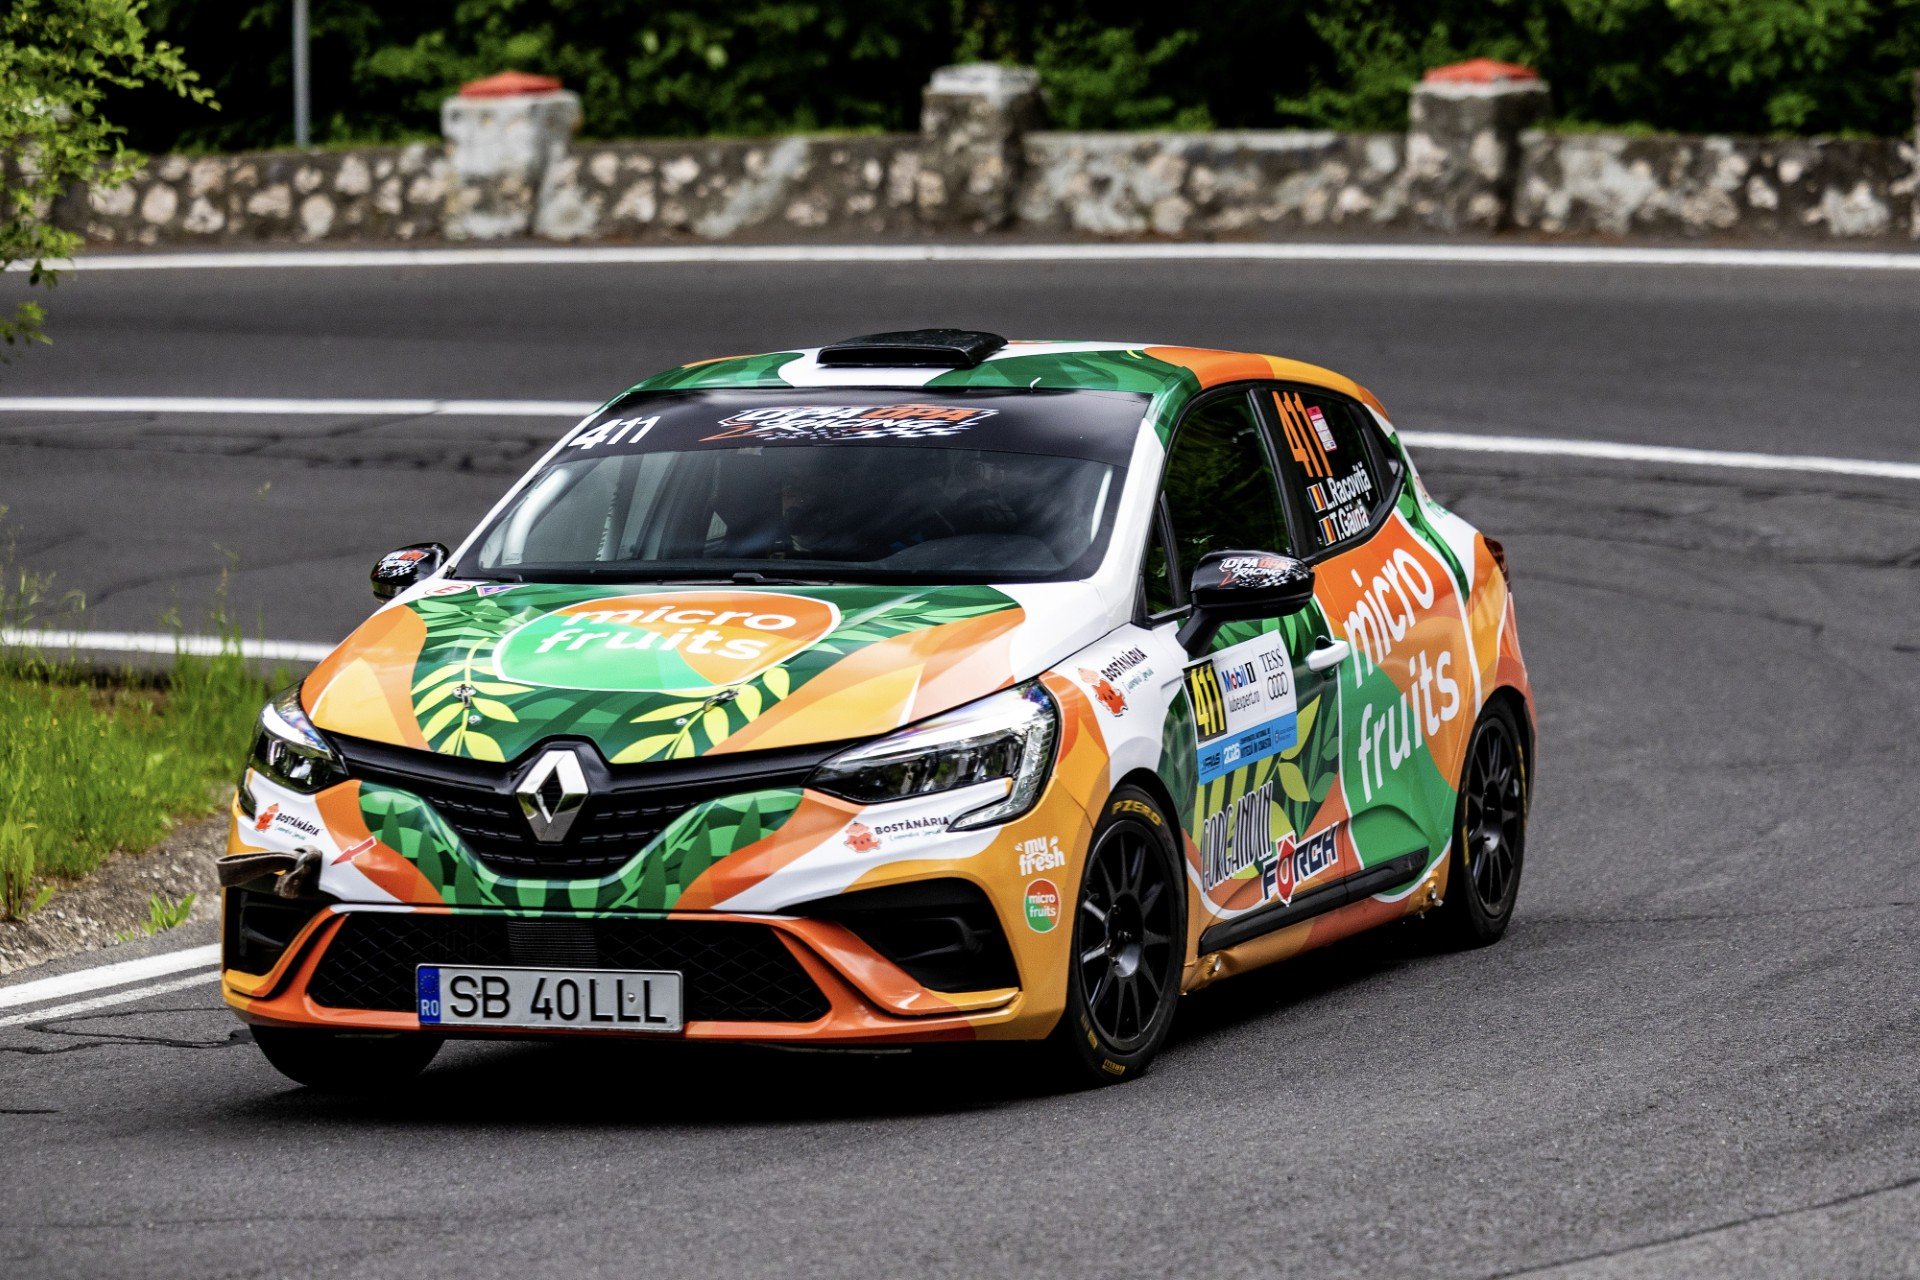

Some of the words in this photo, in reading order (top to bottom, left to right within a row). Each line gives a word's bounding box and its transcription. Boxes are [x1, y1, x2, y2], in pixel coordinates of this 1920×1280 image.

[568, 416, 661, 449] 411
[1272, 390, 1333, 477] 411
[1224, 558, 1258, 569] OPA
[1231, 567, 1284, 580] RACING
[561, 605, 797, 631] micro
[1343, 548, 1434, 689] micro
[535, 627, 768, 660] fruits
[1258, 648, 1284, 673] TESS
[1221, 664, 1248, 692] Mobil
[1245, 661, 1256, 683] 1
[1190, 663, 1225, 736] 411
[1358, 650, 1460, 803] fruits
[1024, 836, 1049, 855] my
[1019, 846, 1066, 876] fresh
[1028, 892, 1056, 904] micro
[1029, 905, 1057, 918] fruits
[420, 999, 439, 1017] RO
[449, 975, 511, 1020] SB
